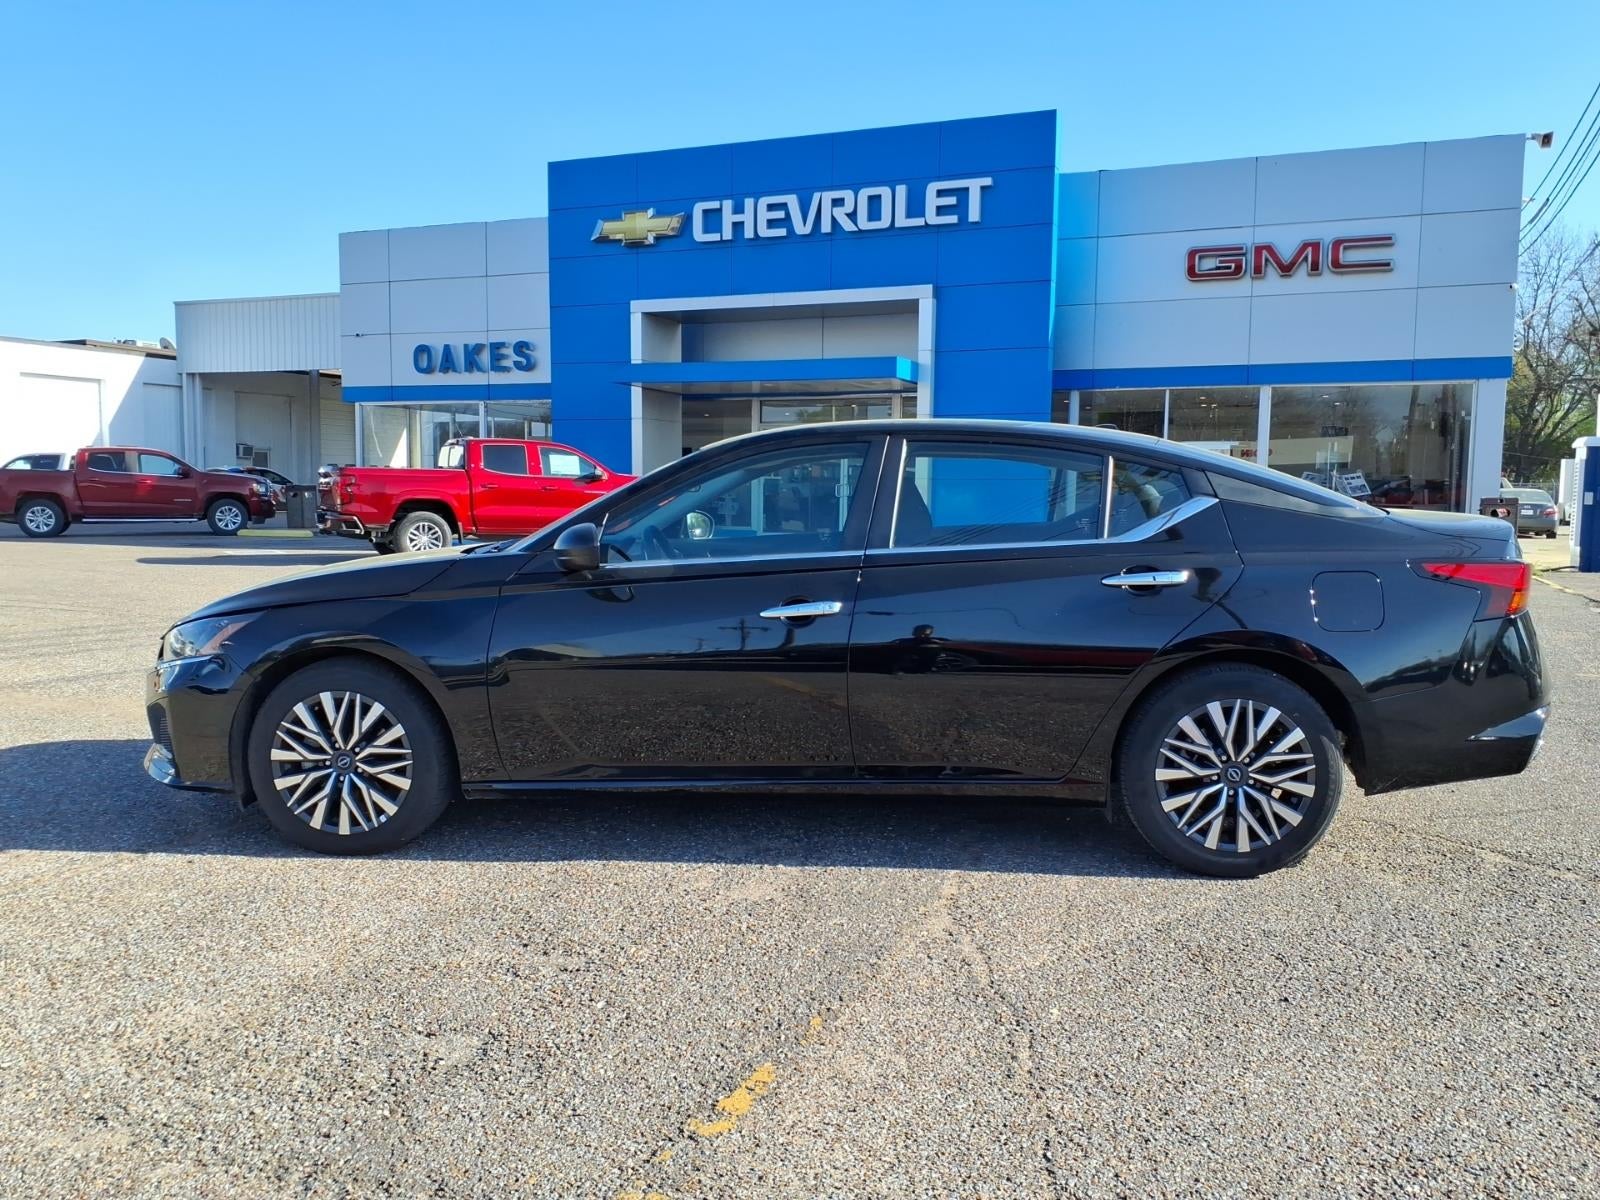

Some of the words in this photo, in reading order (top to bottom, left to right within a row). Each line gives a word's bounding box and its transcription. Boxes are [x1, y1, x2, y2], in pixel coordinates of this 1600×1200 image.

[693, 177, 993, 242] CHEVROLET
[1185, 234, 1395, 281] GMC
[413, 341, 537, 374] OAKES
